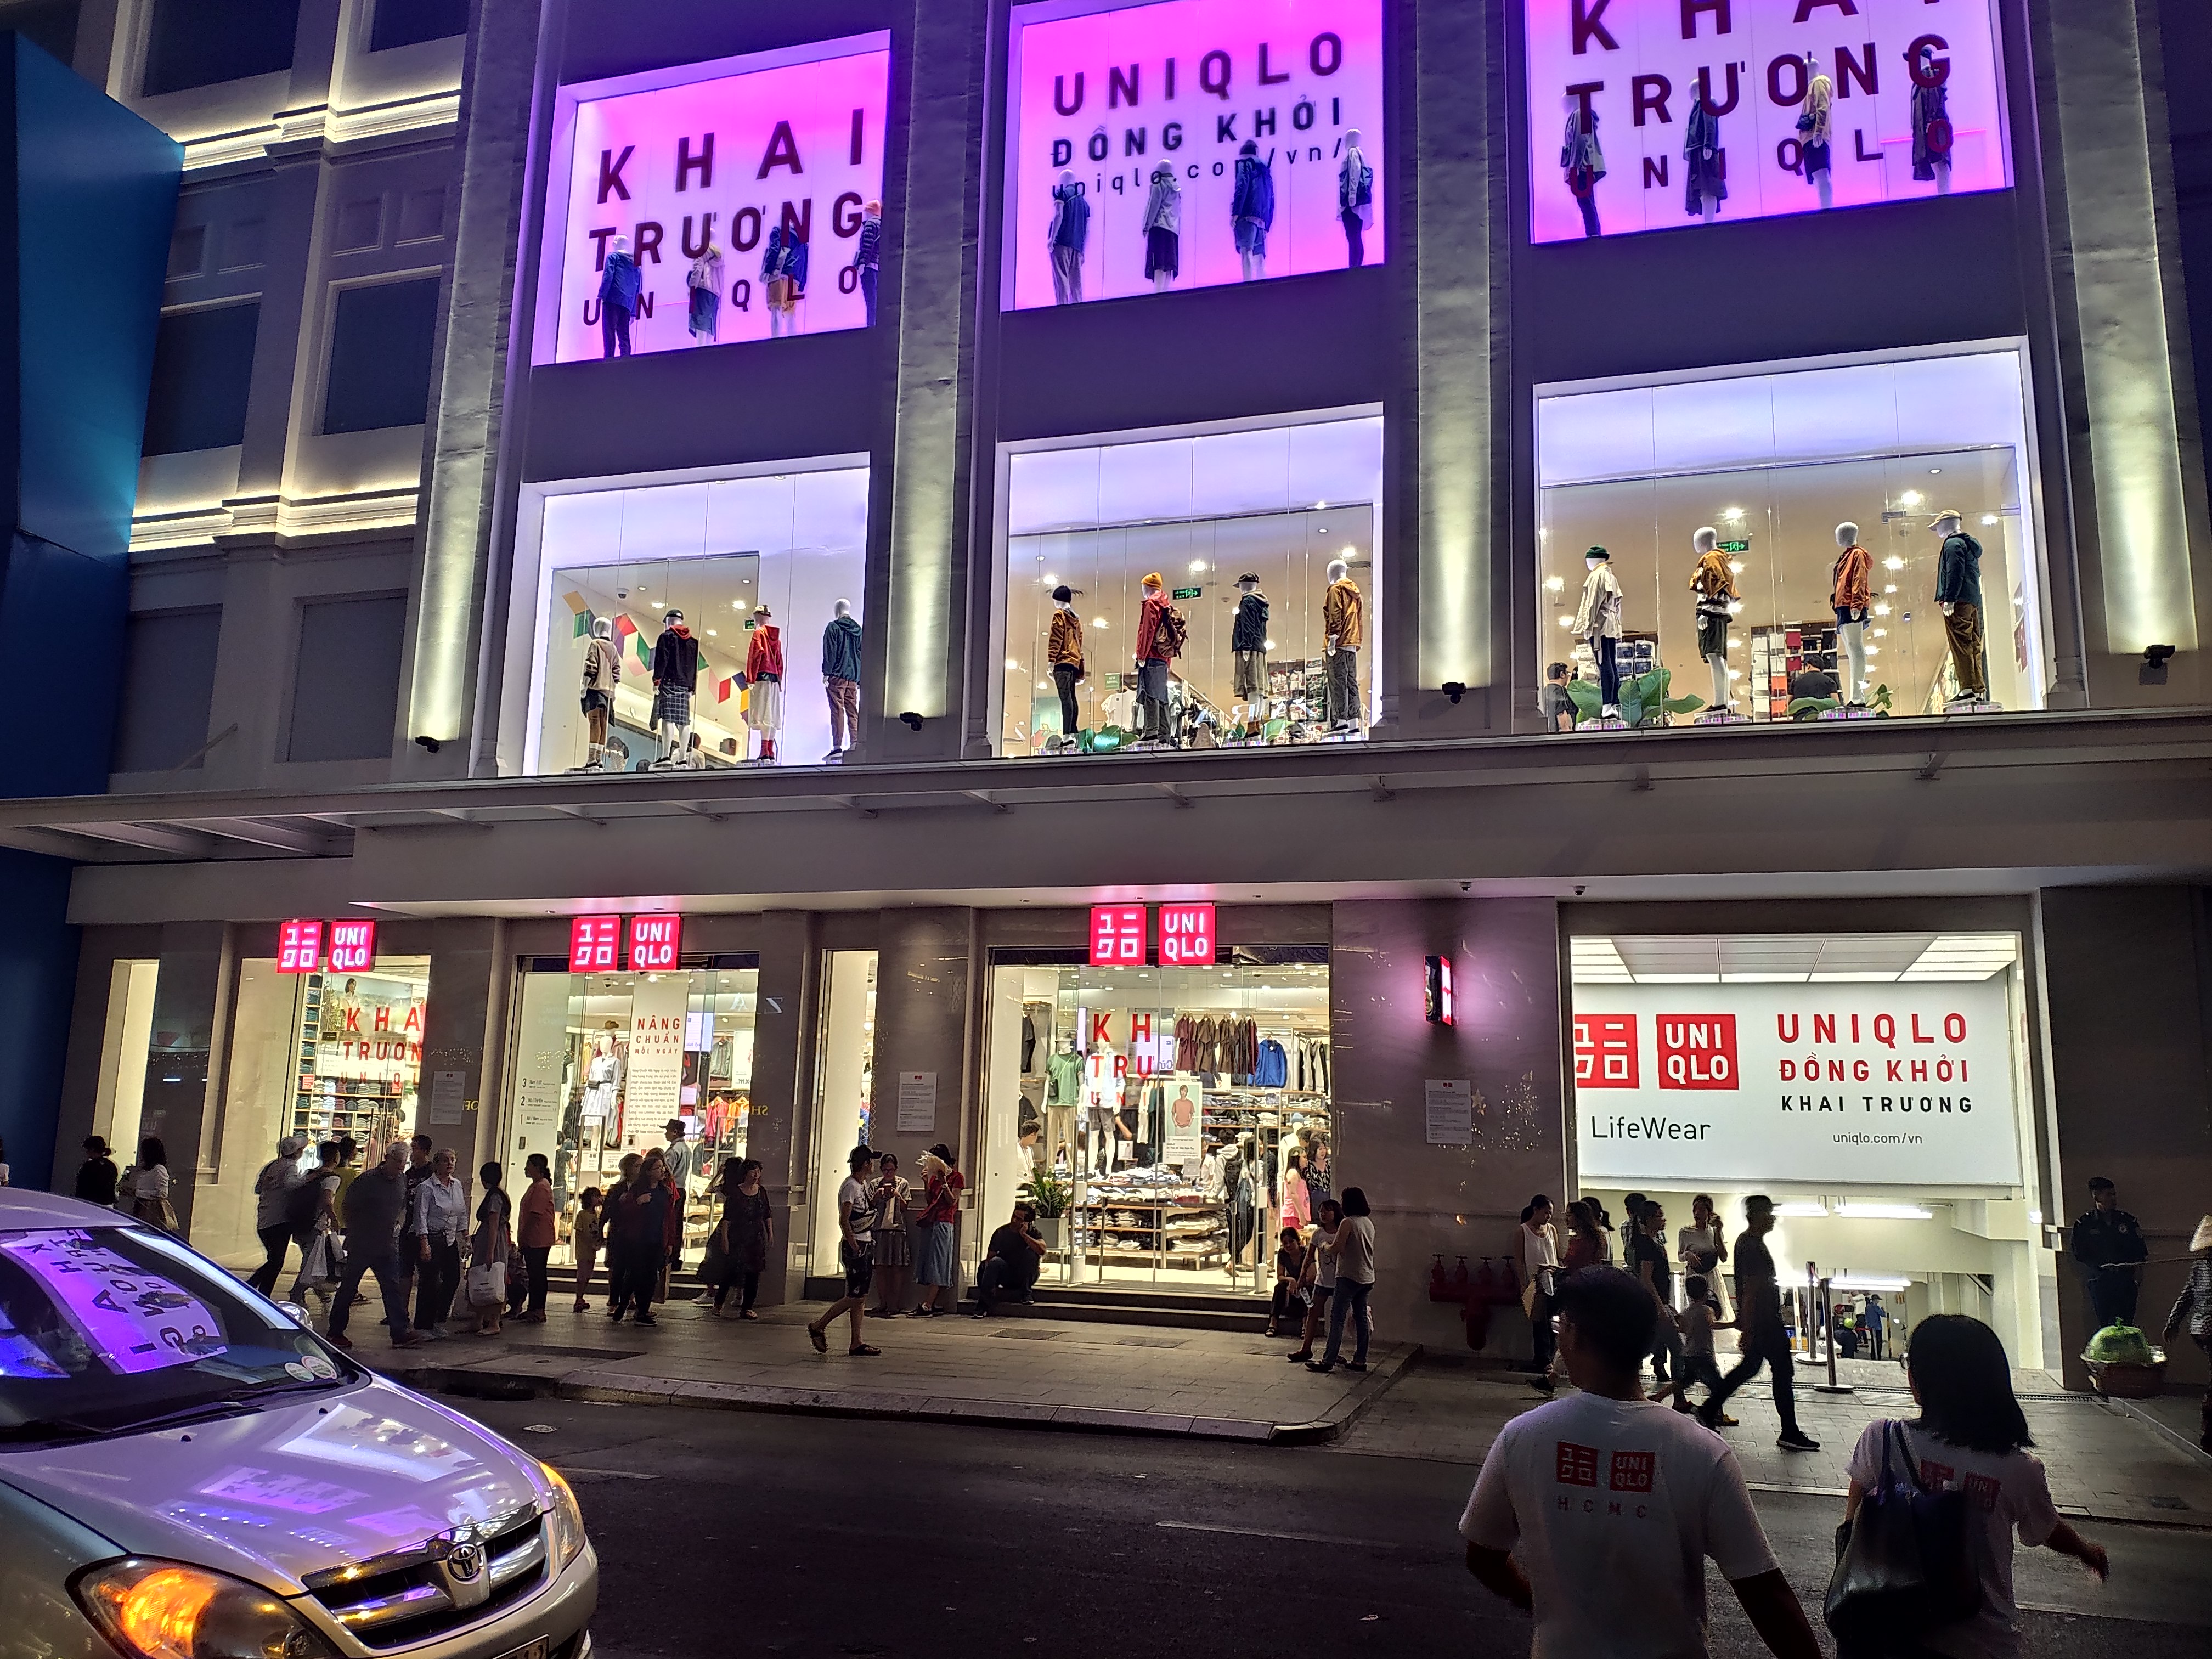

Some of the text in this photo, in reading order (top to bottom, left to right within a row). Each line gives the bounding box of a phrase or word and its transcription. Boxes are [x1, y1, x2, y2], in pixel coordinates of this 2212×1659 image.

[1054, 32, 1342, 116] UNIQLO
[1566, 34, 1951, 135] TRƯƠNG
[1052, 94, 1341, 167] ĐỒNG KHỞI
[597, 108, 864, 205] KHAI
[1569, 119, 1954, 199] UNIQLO
[589, 191, 864, 272] TRƯƠNG
[582, 264, 859, 326] UNIQLO
[636, 923, 671, 941] UNI
[1165, 913, 1205, 933] UNI
[335, 927, 366, 945] UNI
[332, 948, 365, 969] QLO
[634, 945, 672, 967] QLO
[1164, 937, 1209, 961] QLO
[637, 1015, 680, 1030] NÂNG
[1777, 1013, 1967, 1049] UNIQLO
[636, 1031, 679, 1043] CHUẨN
[1666, 1024, 1722, 1049] UNI
[1667, 1054, 1729, 1085] QLO
[1779, 1052, 1968, 1082] ĐỒNG KHỞI
[522, 1077, 527, 1088] 3
[520, 1096, 525, 1106] 2
[1781, 1096, 1972, 1113] KHAI TRƯƠNG
[520, 1114, 523, 1125] 1
[1592, 1116, 1711, 1141] LifeWear
[1832, 1132, 1923, 1146] uniqlo.com/vn
[1616, 1457, 1647, 1470] UNI
[1615, 1472, 1648, 1487] QLO
